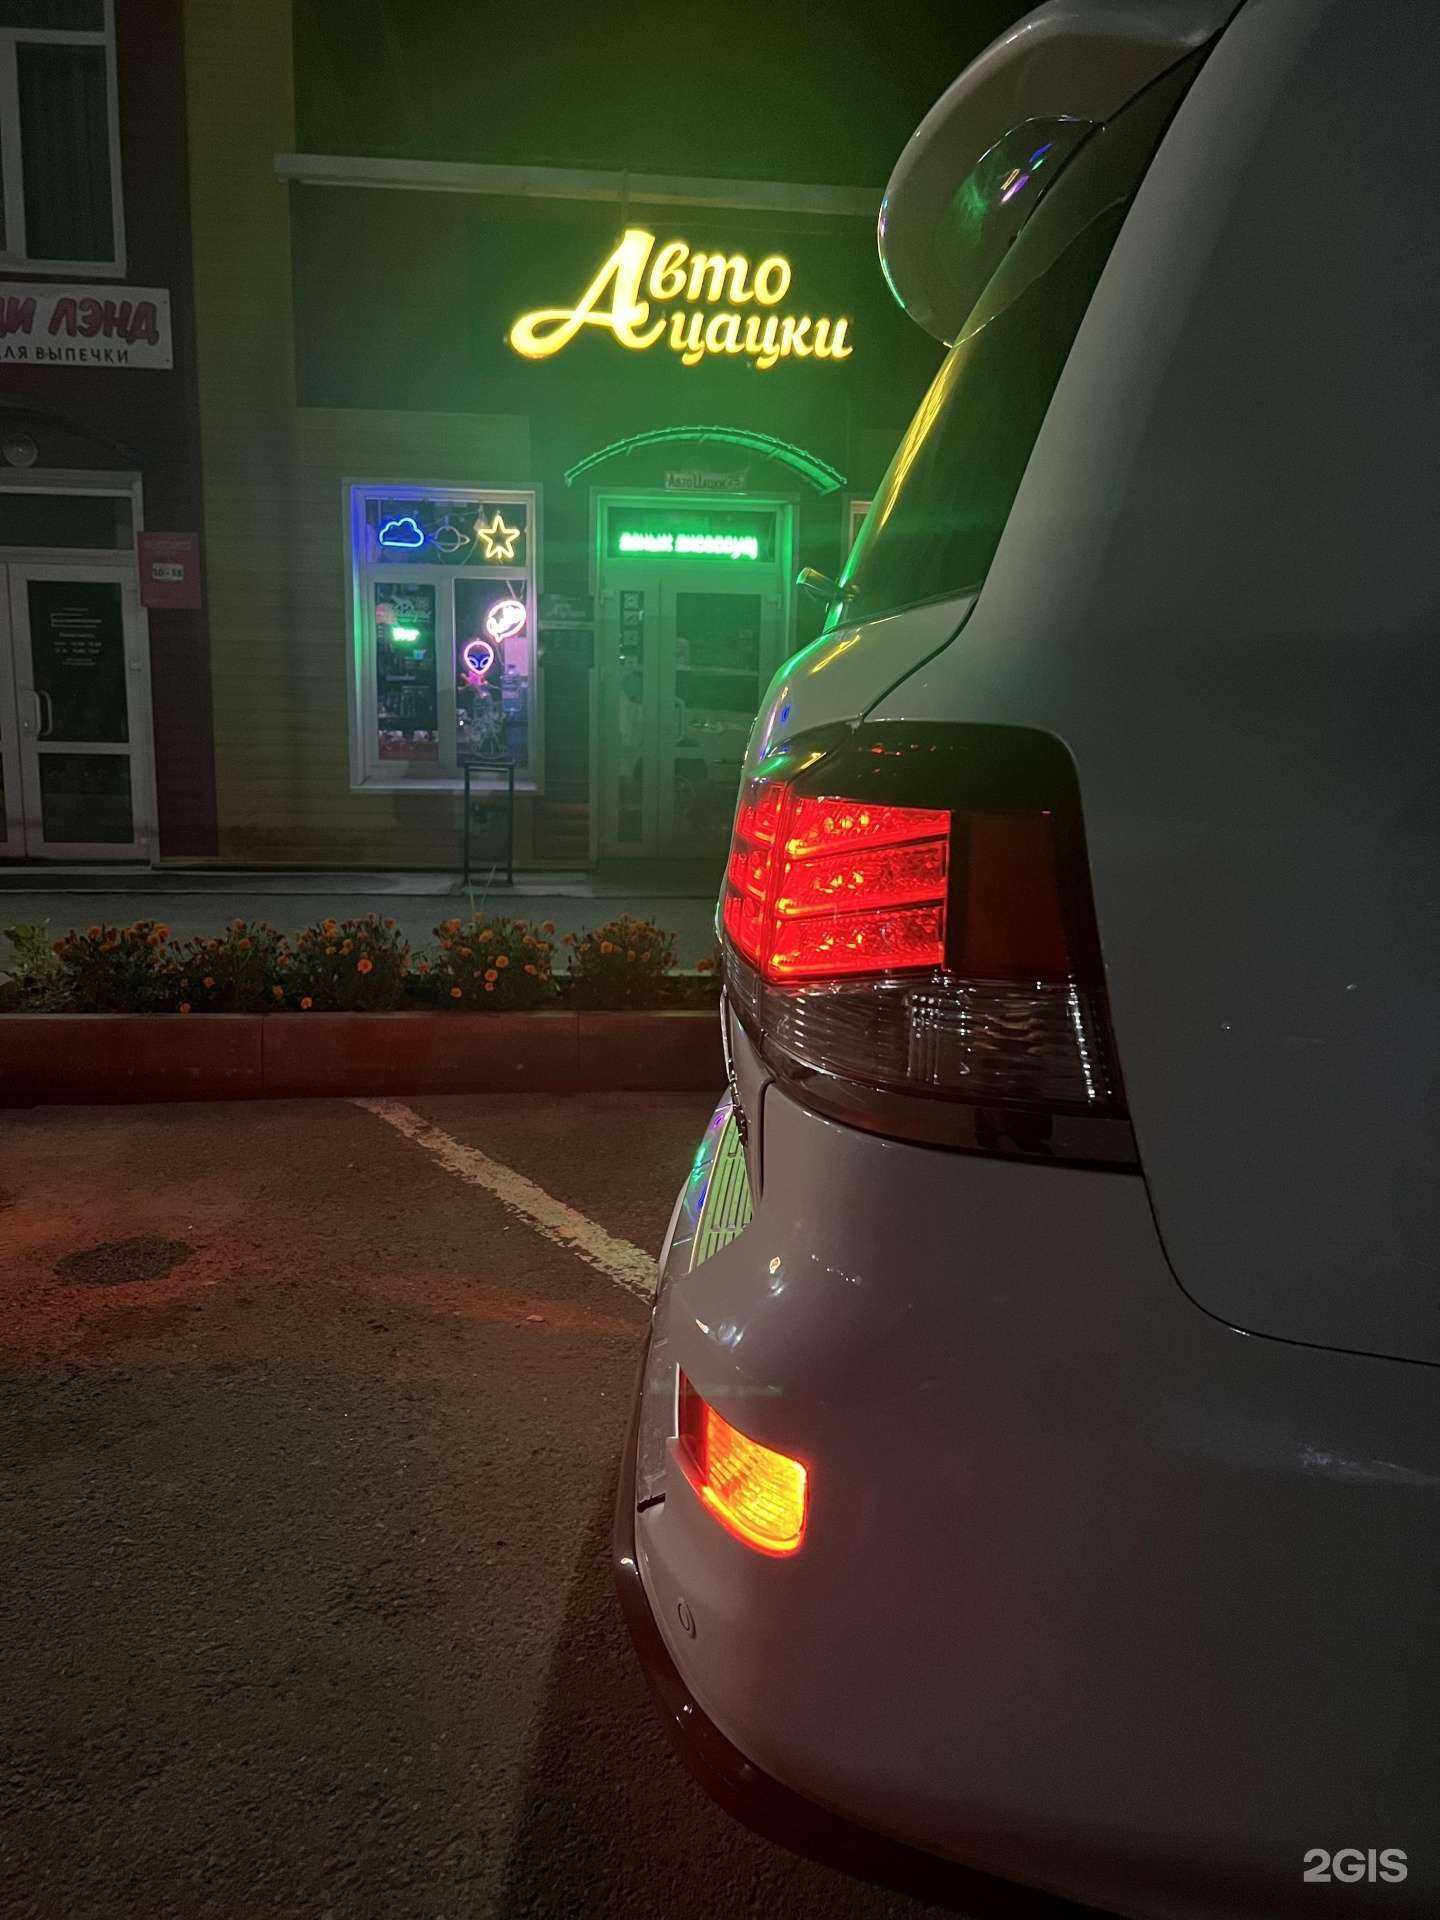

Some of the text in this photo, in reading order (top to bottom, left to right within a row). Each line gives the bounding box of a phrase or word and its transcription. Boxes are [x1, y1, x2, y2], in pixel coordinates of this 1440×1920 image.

[0, 296, 160, 346] И ЛЭНД
[510, 229, 792, 359] Авто
[0, 346, 129, 364] ЛЯ ВЫПЕЧКИ
[669, 311, 853, 369] цацки
